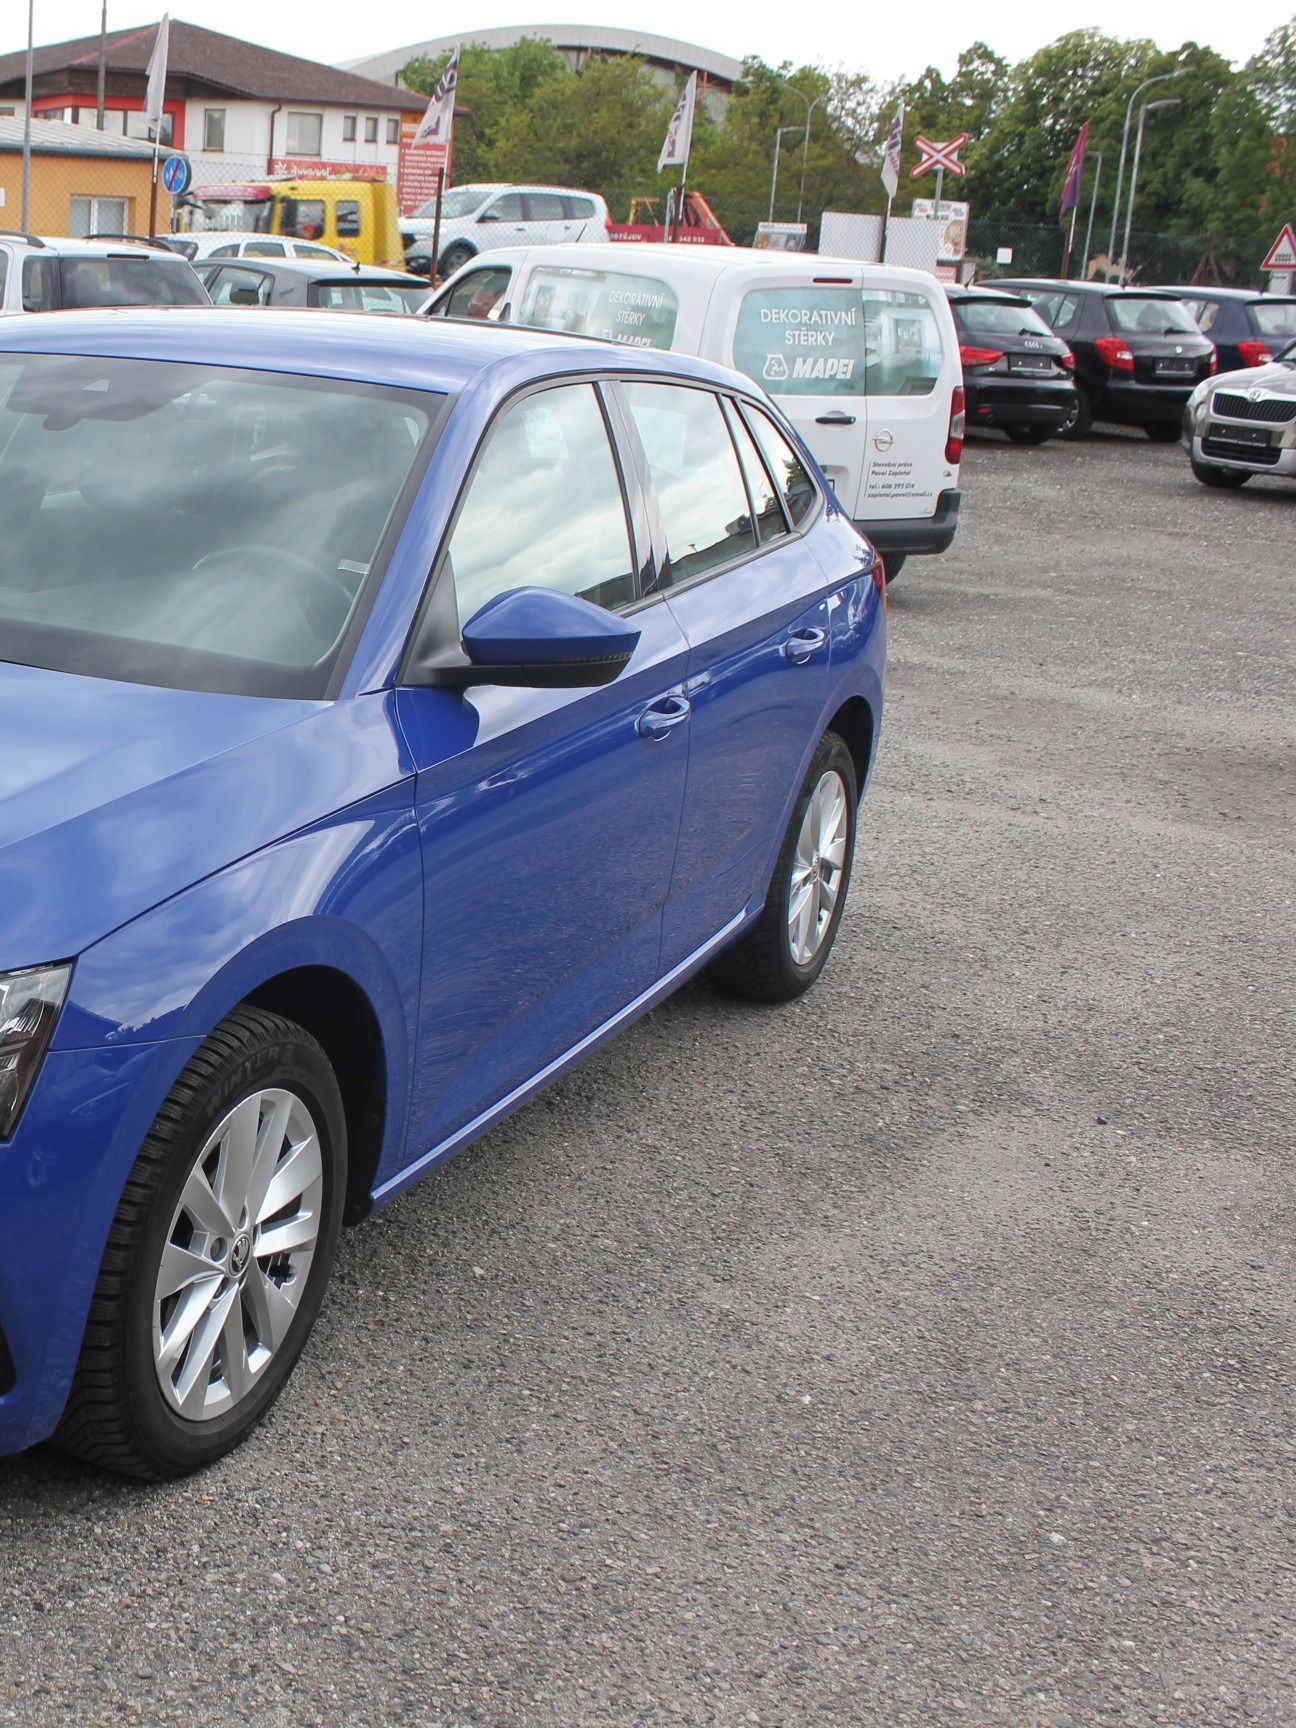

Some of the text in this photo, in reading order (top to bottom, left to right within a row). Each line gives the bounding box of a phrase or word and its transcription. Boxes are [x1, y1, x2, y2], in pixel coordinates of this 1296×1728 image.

[608, 289, 664, 309] DEKORATIVNÍ
[760, 307, 856, 326] DEKORATIVNÍ
[785, 327, 835, 346] STĚRKY
[792, 357, 855, 379] MAPEI
